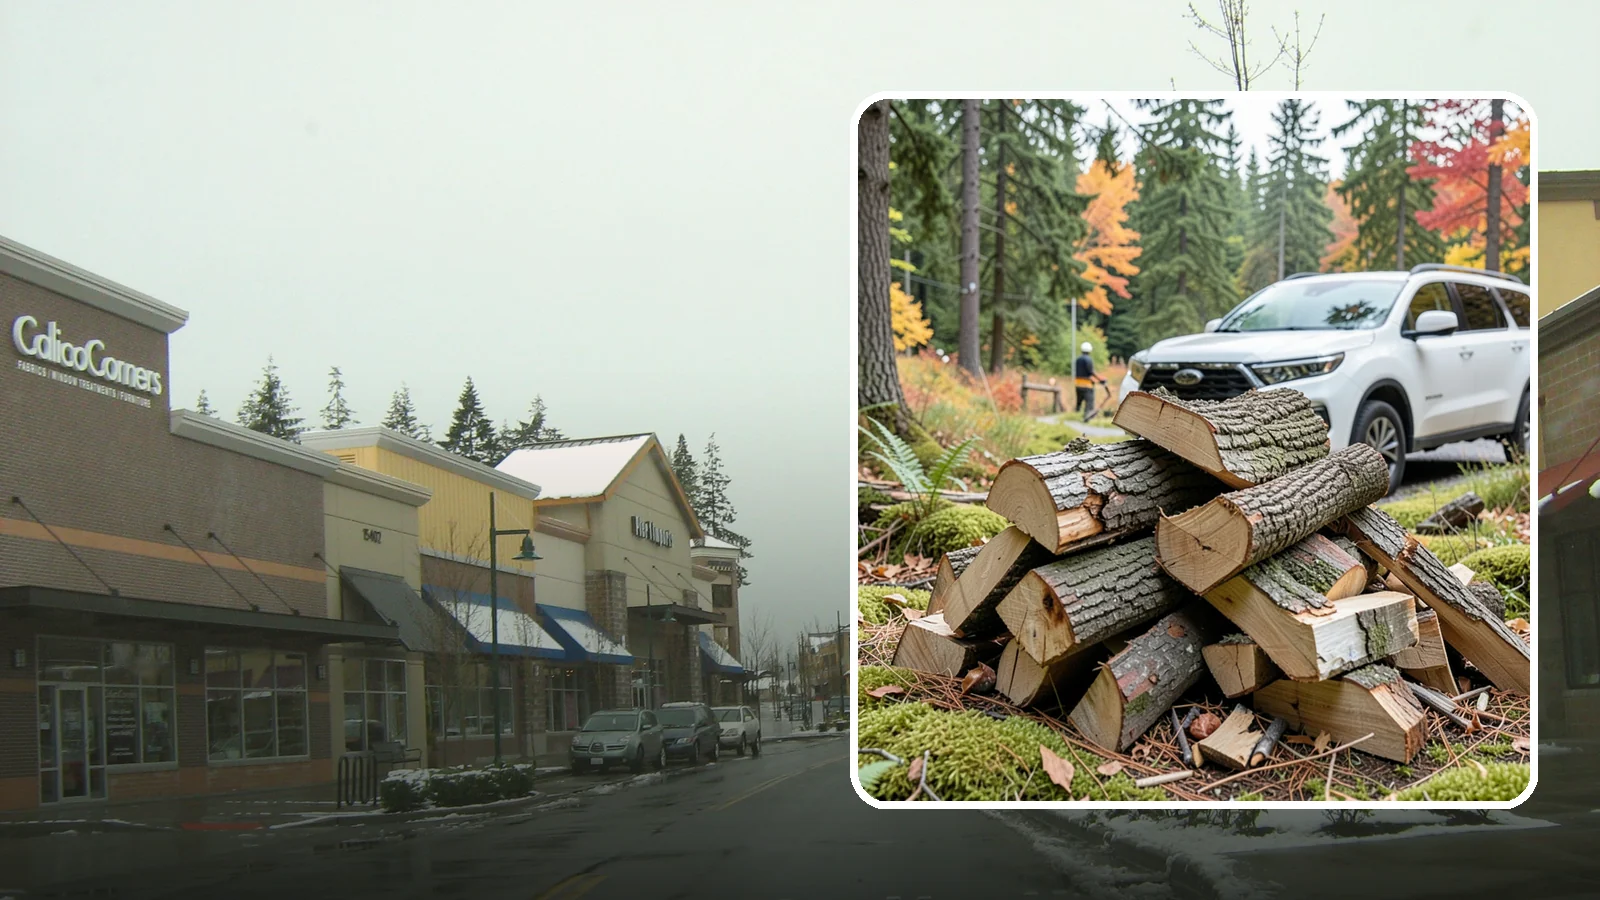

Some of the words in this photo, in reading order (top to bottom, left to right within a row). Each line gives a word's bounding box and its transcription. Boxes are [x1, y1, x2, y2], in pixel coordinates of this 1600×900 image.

[17, 359, 47, 378] FABRICS
[51, 369, 78, 387] WINDOW
[79, 377, 117, 398] TREATMENTS
[120, 391, 151, 409] FURNITURE
